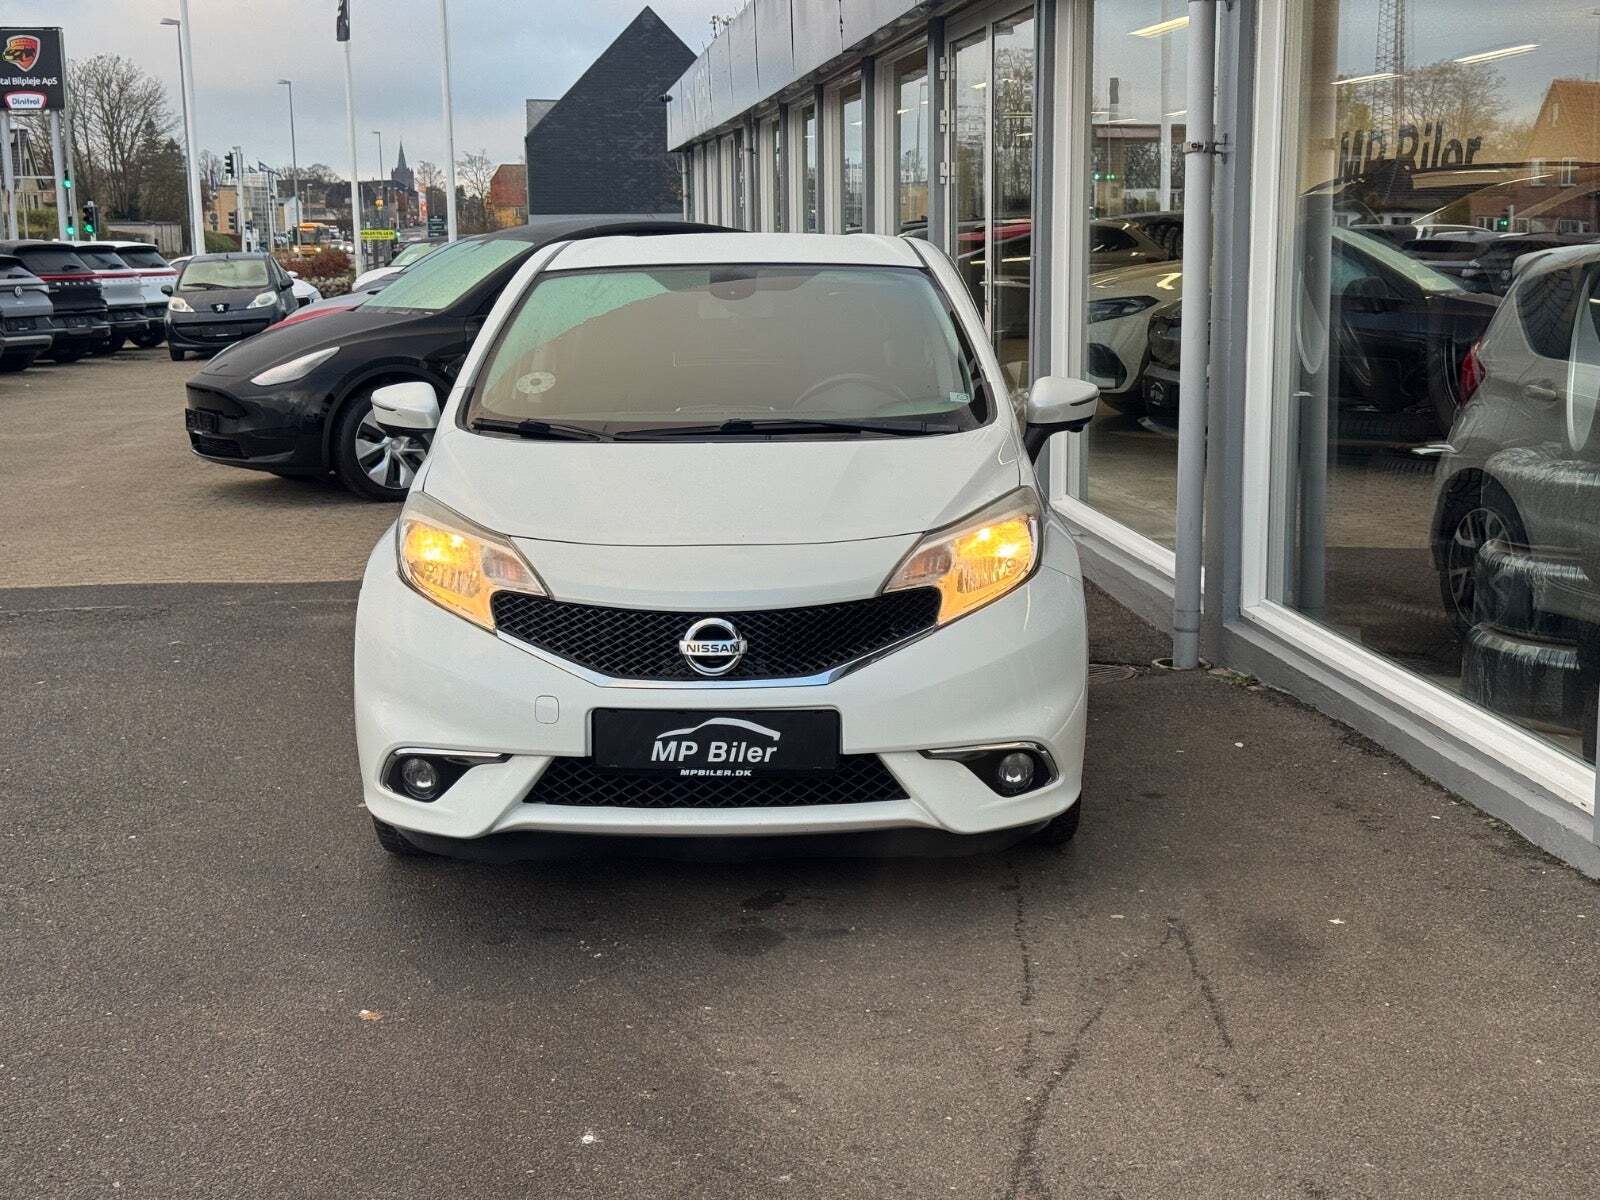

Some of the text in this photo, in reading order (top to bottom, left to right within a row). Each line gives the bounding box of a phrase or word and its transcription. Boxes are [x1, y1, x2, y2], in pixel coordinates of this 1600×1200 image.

[12, 77, 41, 86] Bilpleje
[42, 77, 58, 86] ApS
[12, 97, 40, 105] Dinitrol
[686, 643, 740, 653] NISSAN
[651, 741, 778, 763] MP Biler
[680, 769, 752, 777] MPBILER.DK
